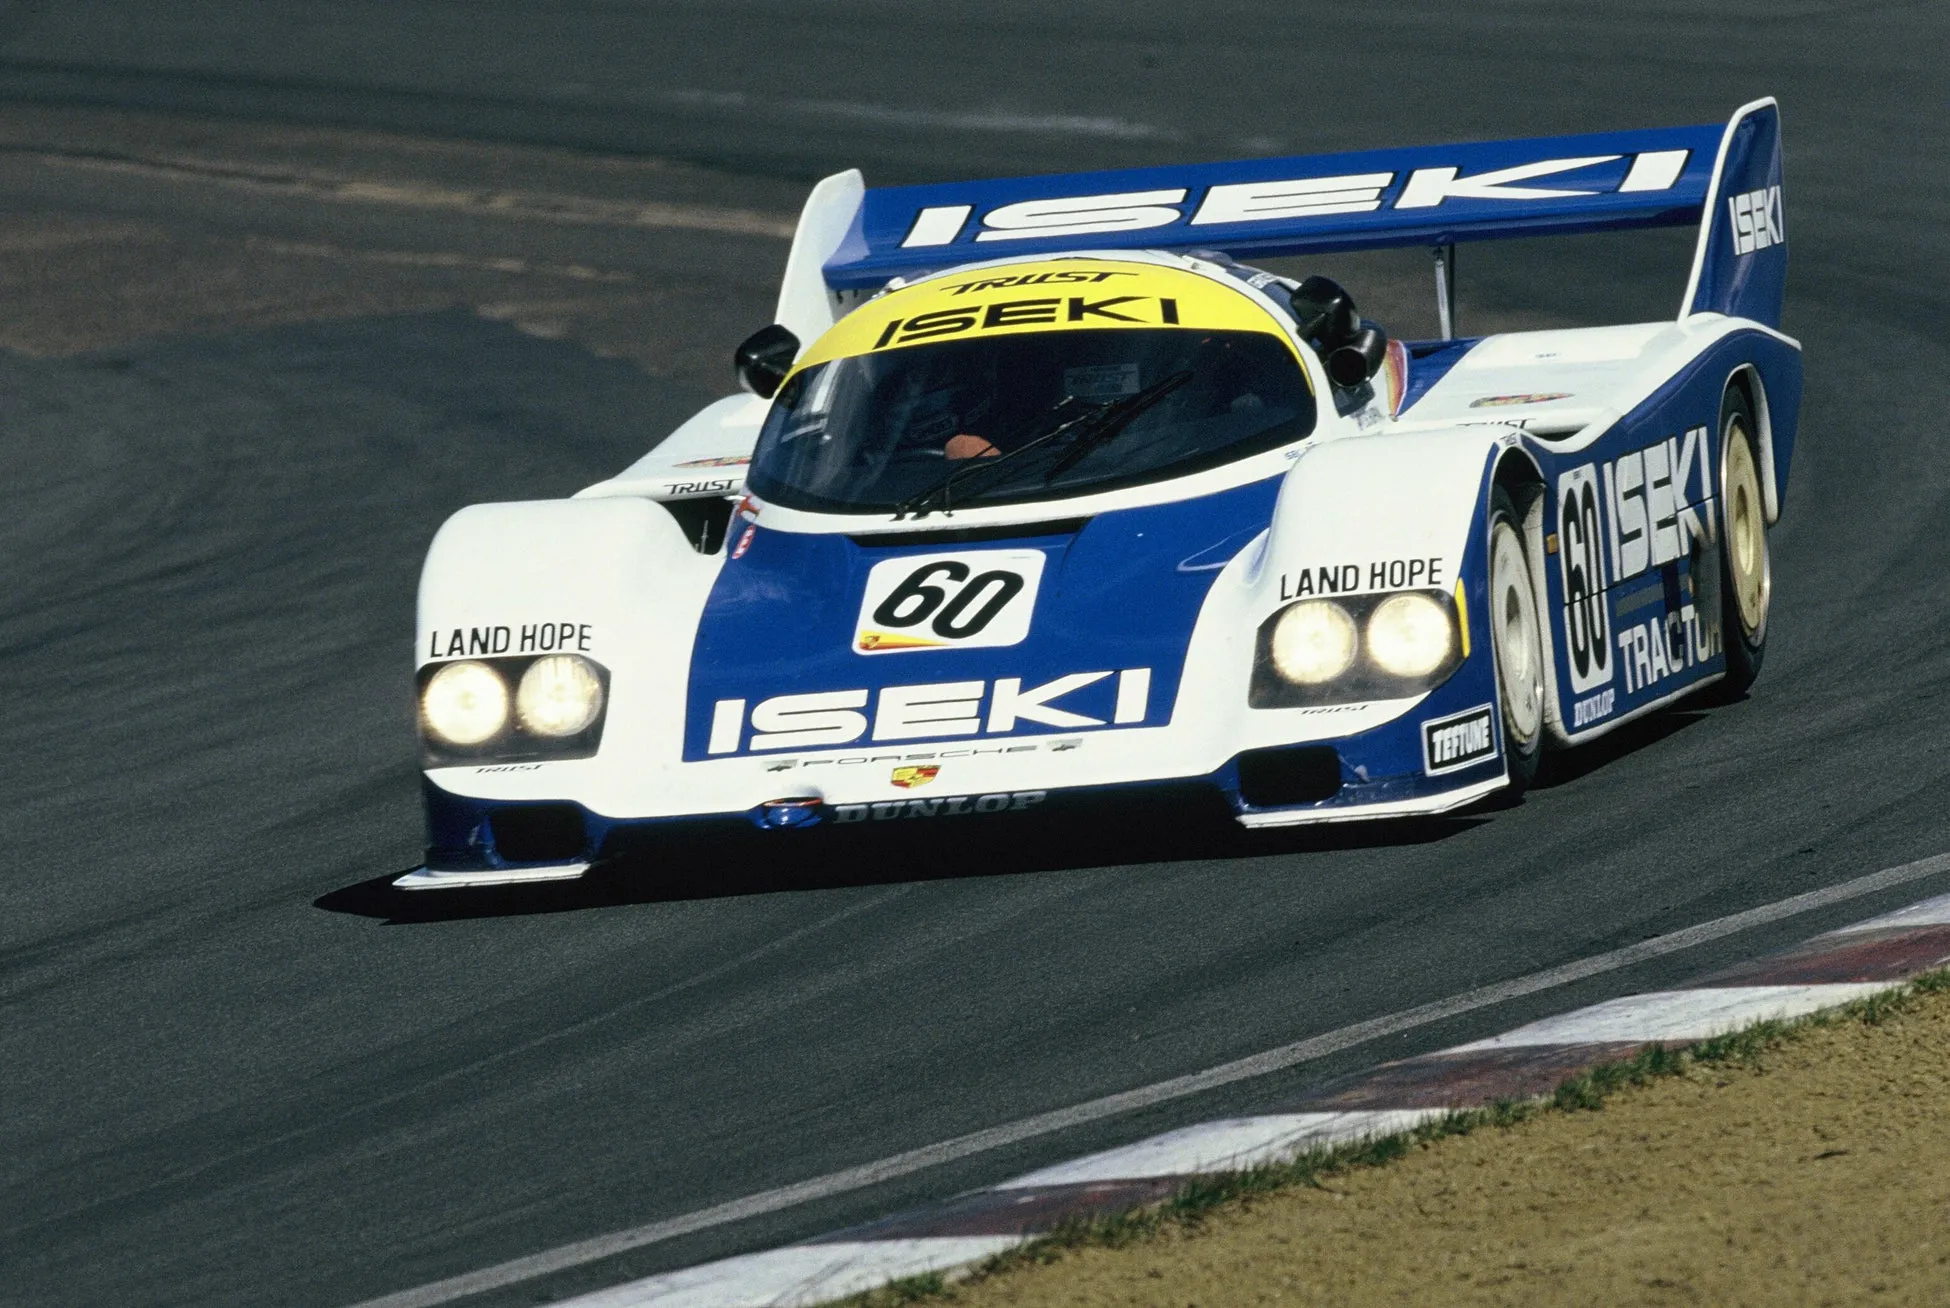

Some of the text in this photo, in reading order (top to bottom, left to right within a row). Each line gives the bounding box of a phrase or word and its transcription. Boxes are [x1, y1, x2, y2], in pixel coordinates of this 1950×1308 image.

[900, 149, 1692, 248] ISEKI
[1728, 185, 1784, 255] ISEKI
[940, 271, 1139, 295] TRUST
[874, 296, 1179, 350] ISEKI
[664, 478, 743, 494] TRUST
[1602, 426, 1717, 582] ISEKI
[872, 561, 1024, 639] 60
[1280, 557, 1443, 601] LAND HOPE
[1562, 480, 1607, 680] 60
[430, 622, 592, 657] LAND HOPE
[708, 668, 1152, 755] ISEKI
[803, 745, 1037, 767] PORSCHE
[833, 791, 1047, 824] DUNLOP
